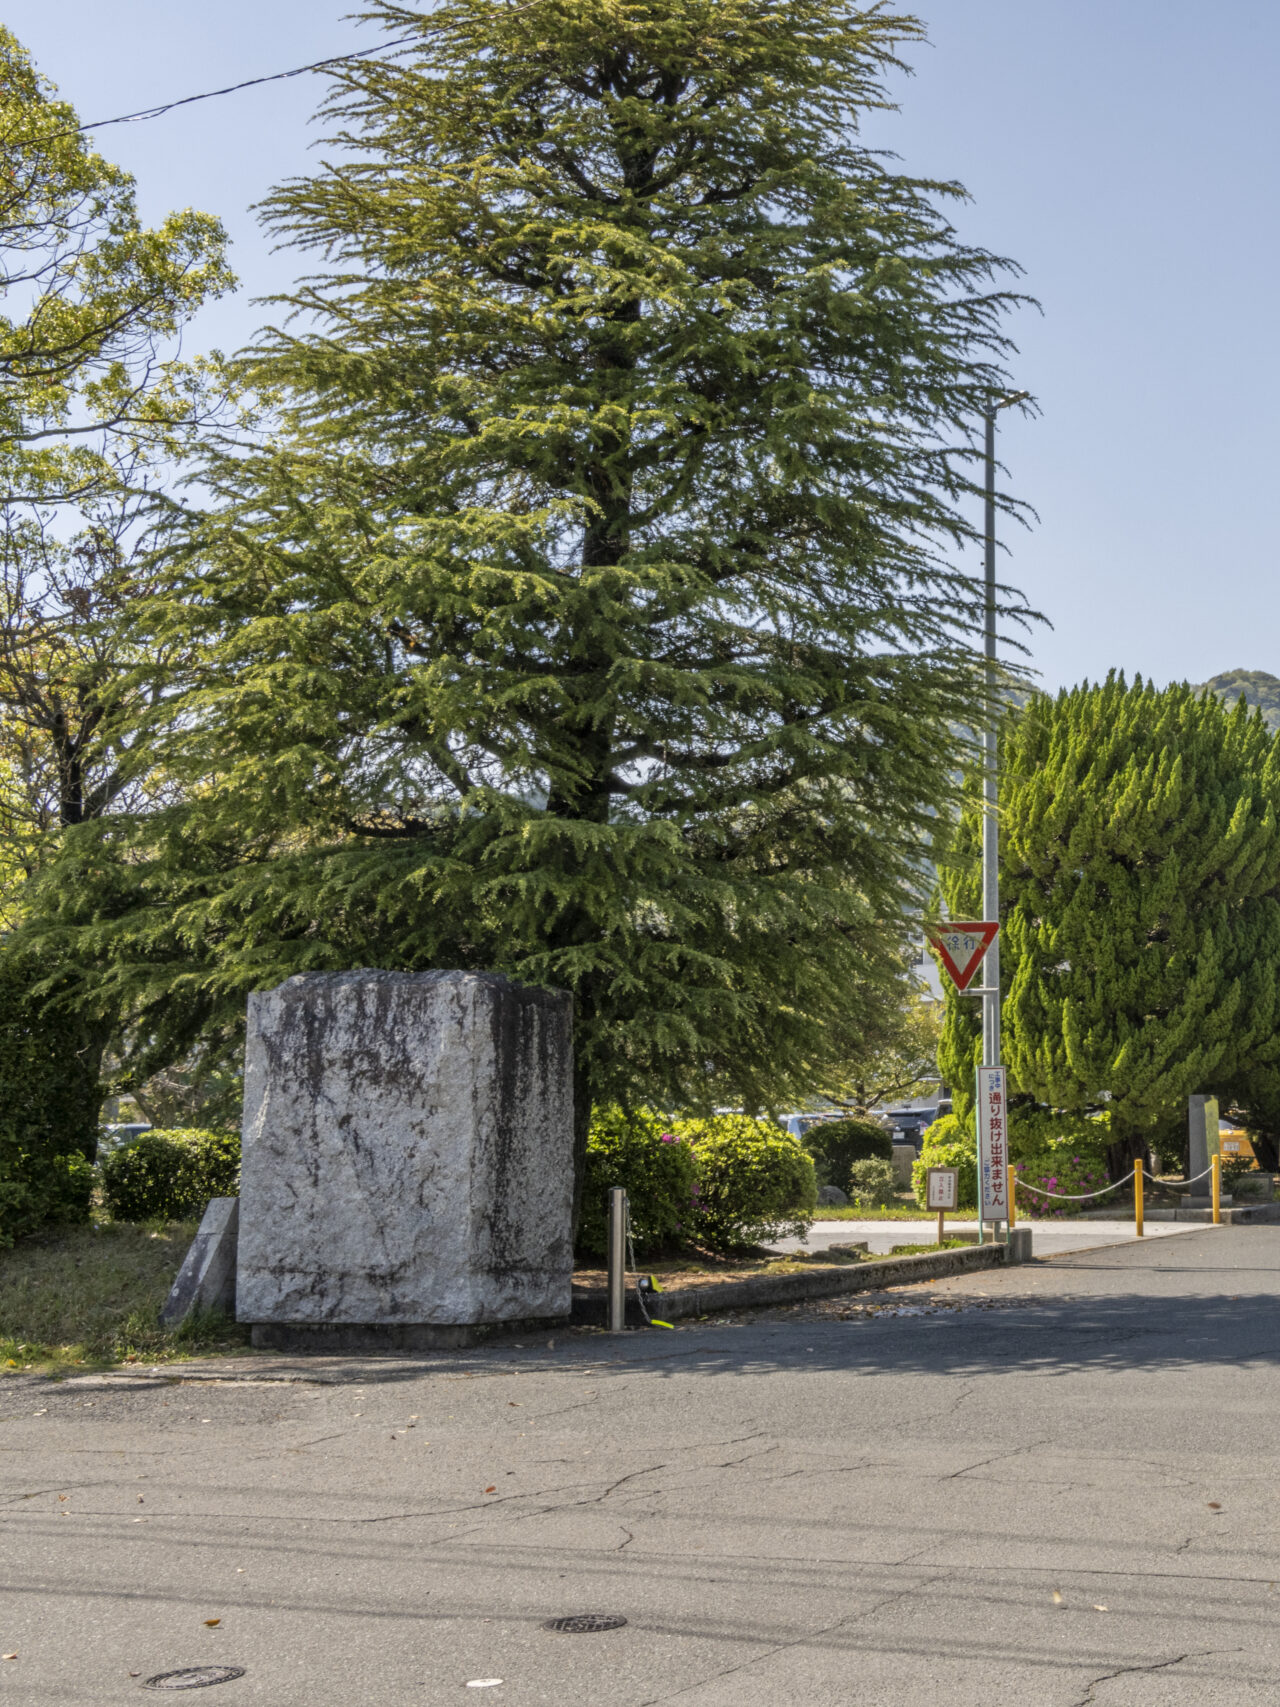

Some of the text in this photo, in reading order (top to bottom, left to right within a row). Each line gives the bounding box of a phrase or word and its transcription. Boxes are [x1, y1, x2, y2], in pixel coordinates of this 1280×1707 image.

[947, 935, 975, 951] 徐行
[989, 1092, 1004, 1206] 通り抜け出来ません
